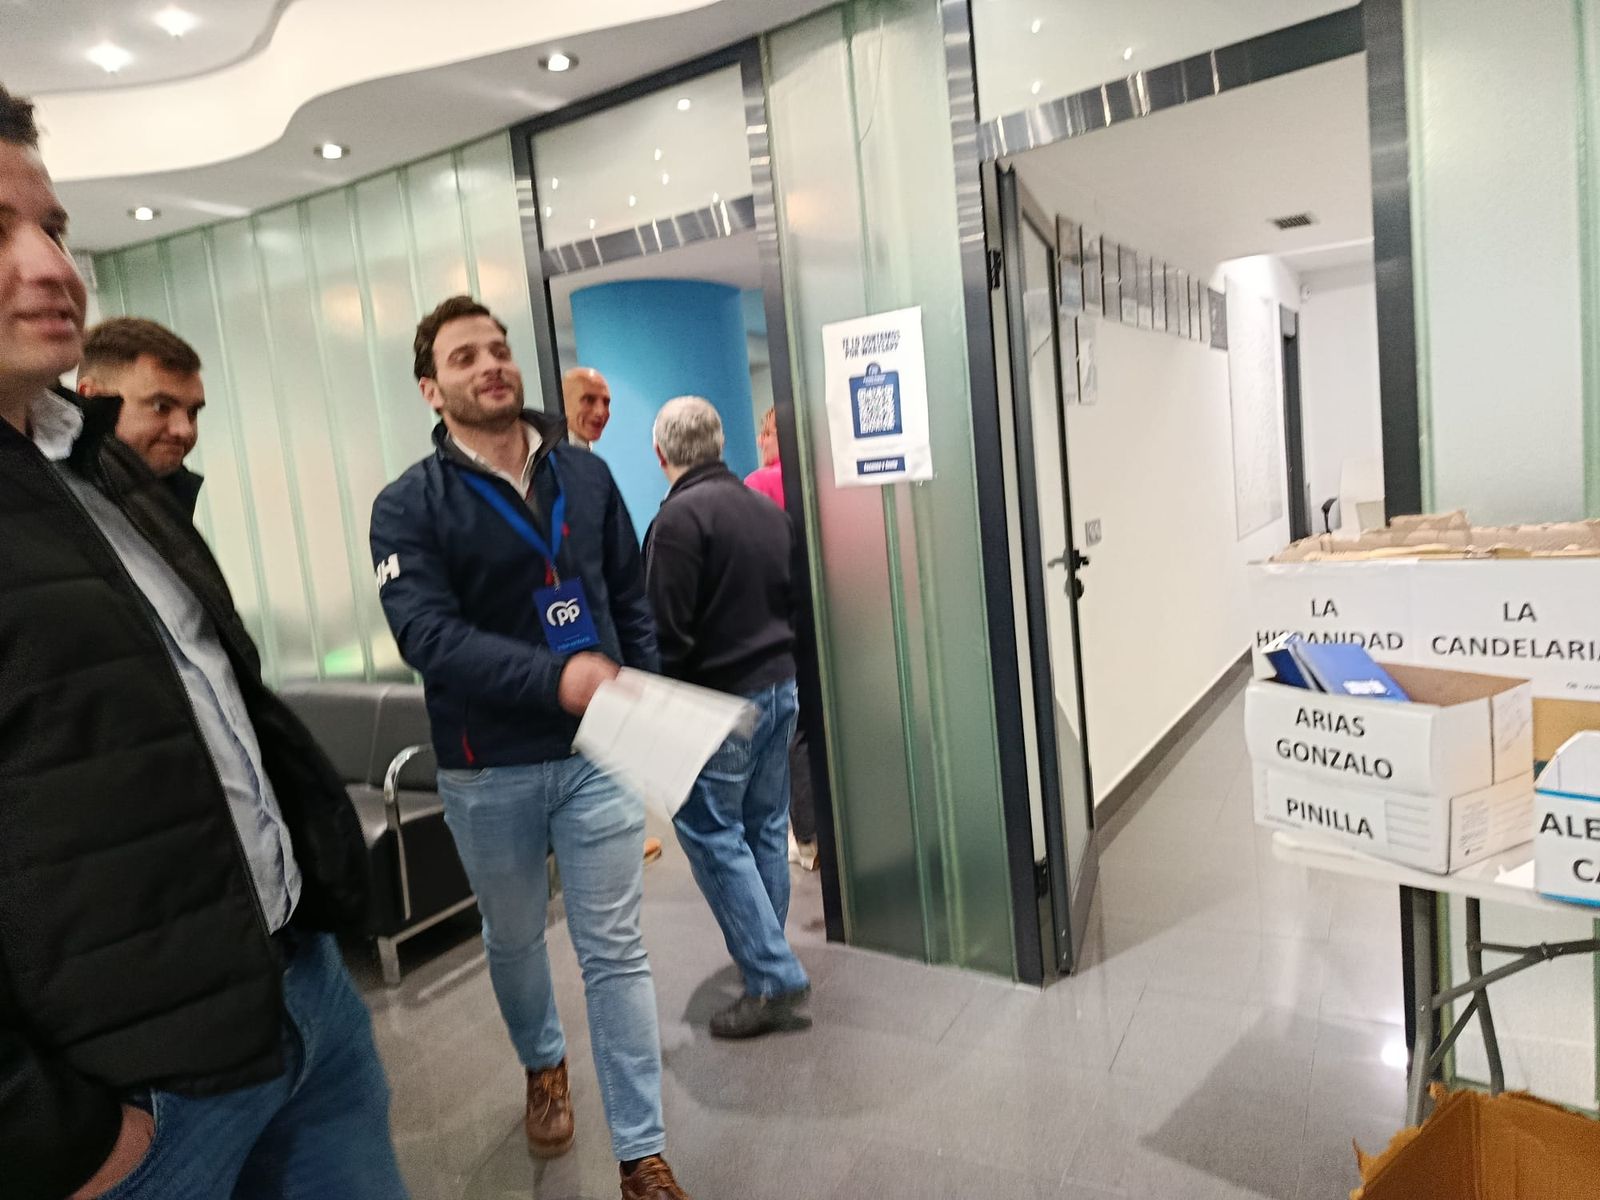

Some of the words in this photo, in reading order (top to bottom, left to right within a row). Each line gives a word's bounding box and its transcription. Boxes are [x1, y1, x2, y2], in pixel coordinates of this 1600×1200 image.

[1311, 598, 1338, 617] LA
[1503, 601, 1537, 622] LA
[1431, 635, 1600, 661] CANDELARI
[1295, 707, 1365, 737] ARIAS
[1276, 737, 1393, 779] GONZALO
[1286, 797, 1374, 839] PINILLA
[1573, 858, 1600, 883] C
